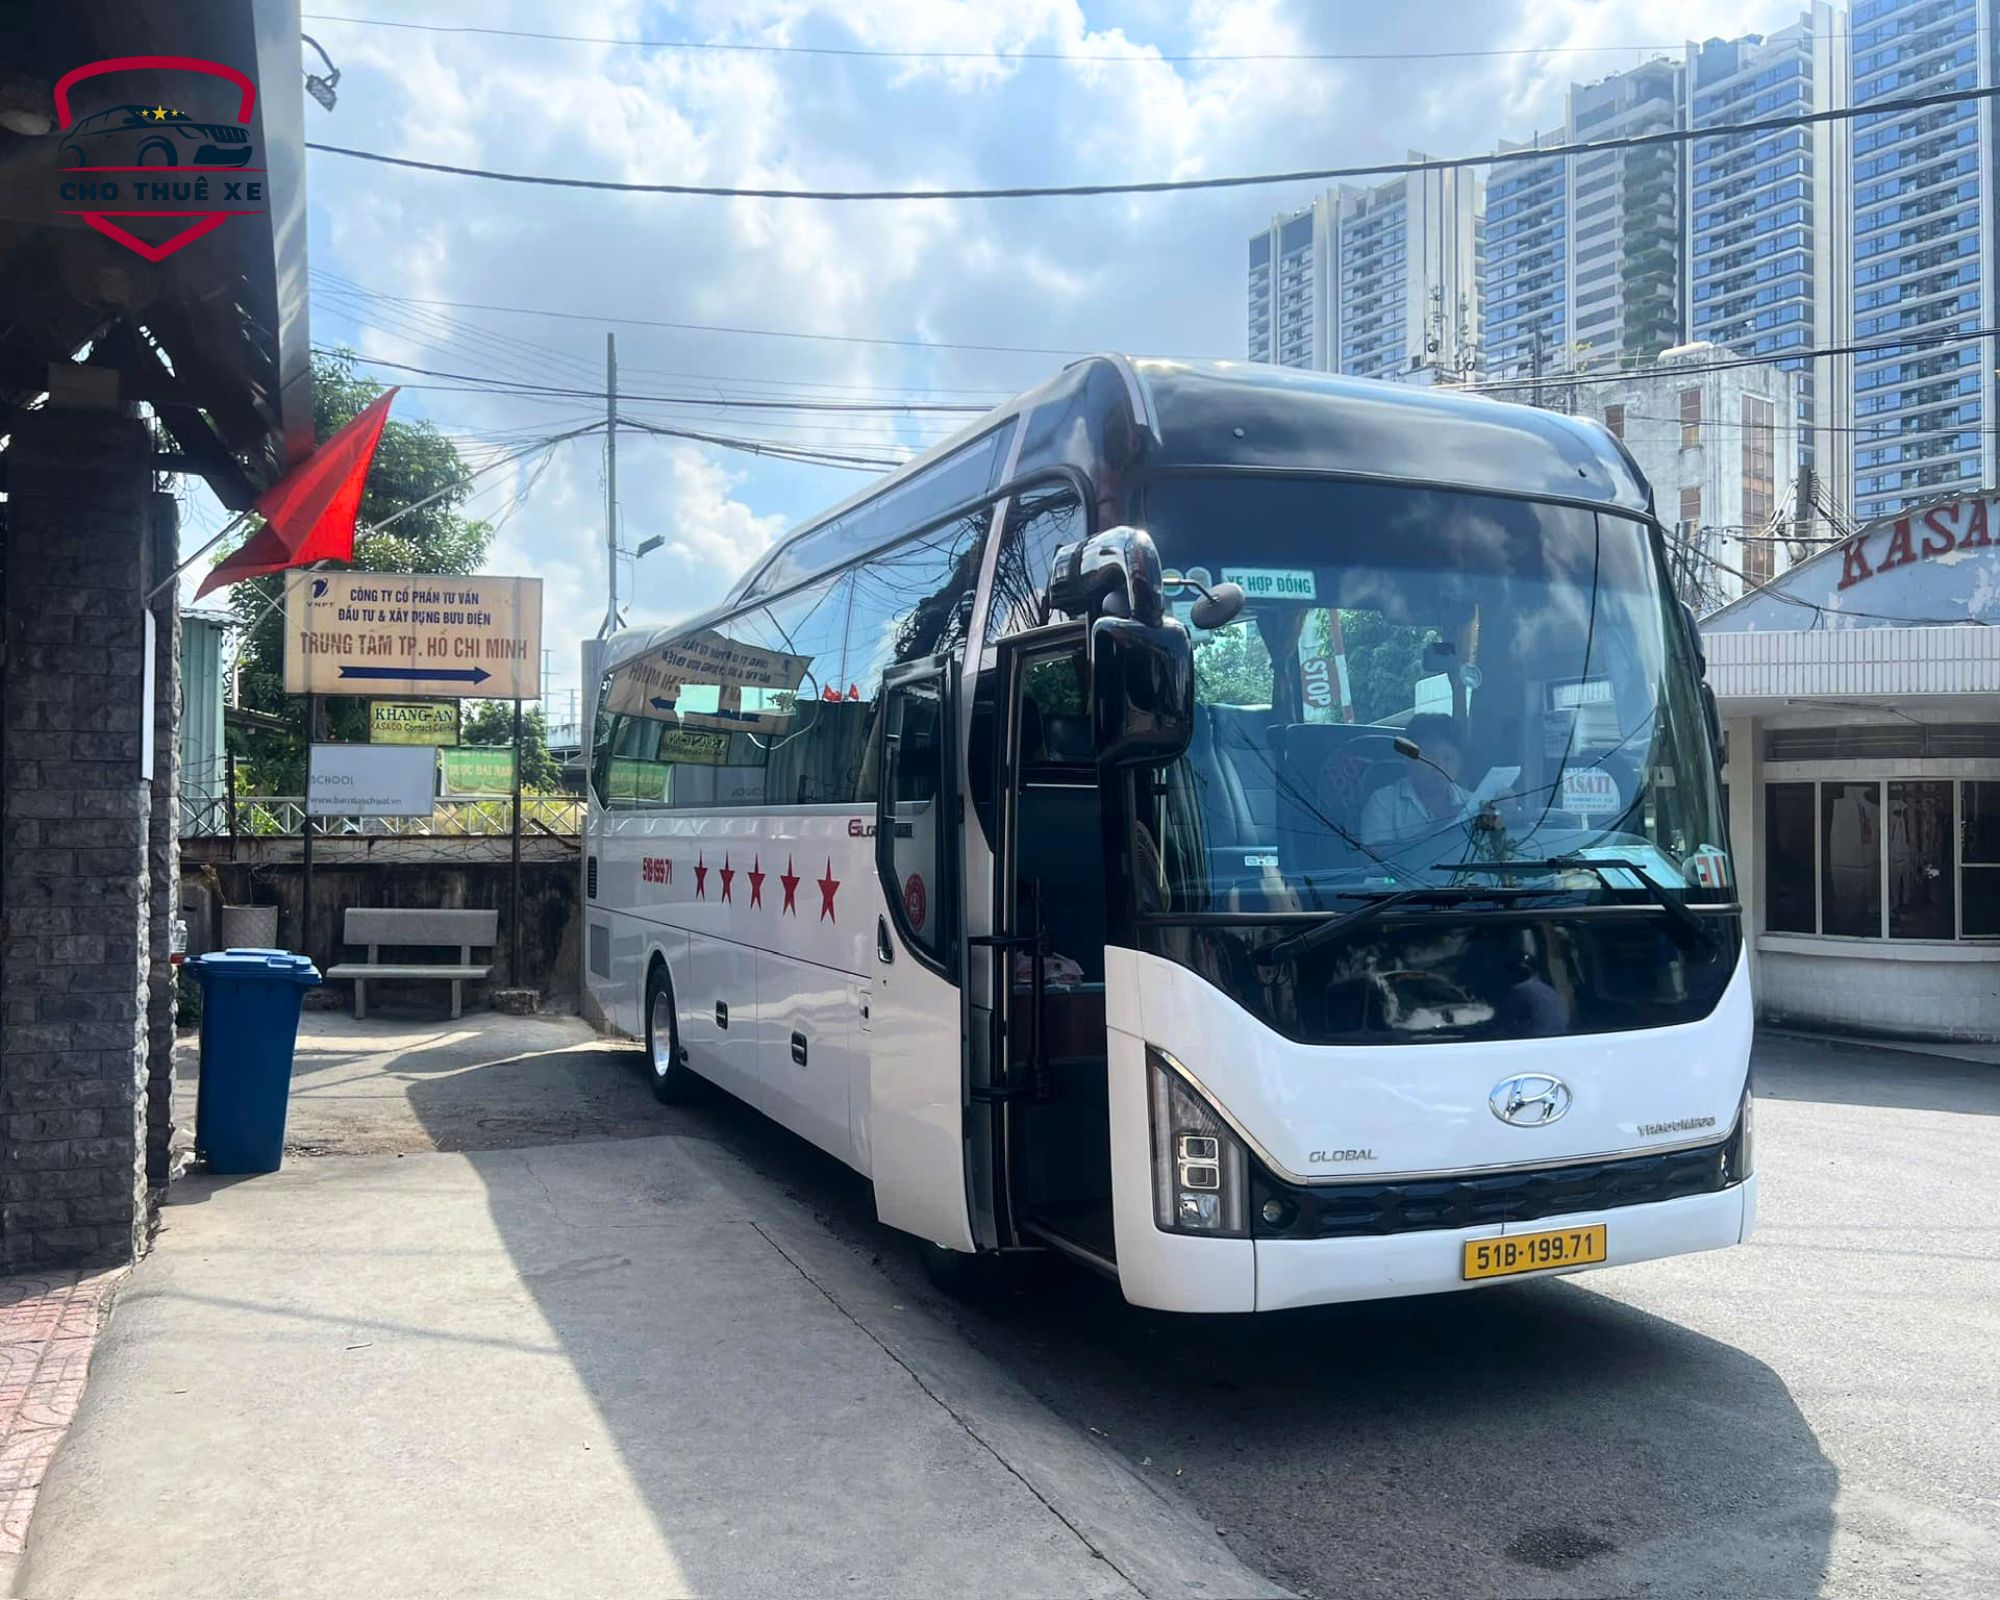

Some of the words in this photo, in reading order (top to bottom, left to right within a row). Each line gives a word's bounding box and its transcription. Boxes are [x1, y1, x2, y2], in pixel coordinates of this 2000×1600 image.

[1837, 499, 2000, 591] KASA
[351, 586, 378, 601] CÔNG
[380, 590, 392, 602] TY
[443, 591, 456, 604] TƯ
[458, 588, 479, 605] VẤN
[1248, 576, 1273, 595] HỢP
[1277, 573, 1311, 594] ĐỒNG
[338, 604, 359, 621] ĐẦU
[362, 609, 375, 621] TƯ
[378, 610, 385, 622] &
[389, 607, 409, 623] XÂY
[412, 610, 440, 625] DỰNG
[467, 610, 491, 627] ĐIỆN
[300, 631, 352, 655] TRUNG
[358, 628, 392, 655] TÂM
[399, 635, 422, 656] TP.
[427, 628, 448, 657] HỒ
[486, 638, 527, 660] MINH
[1303, 659, 1332, 706] STOP
[311, 775, 354, 785] SCHOOL
[1309, 1148, 1378, 1163] GLOBAL
[1477, 1233, 1592, 1270] 51B-199.71
